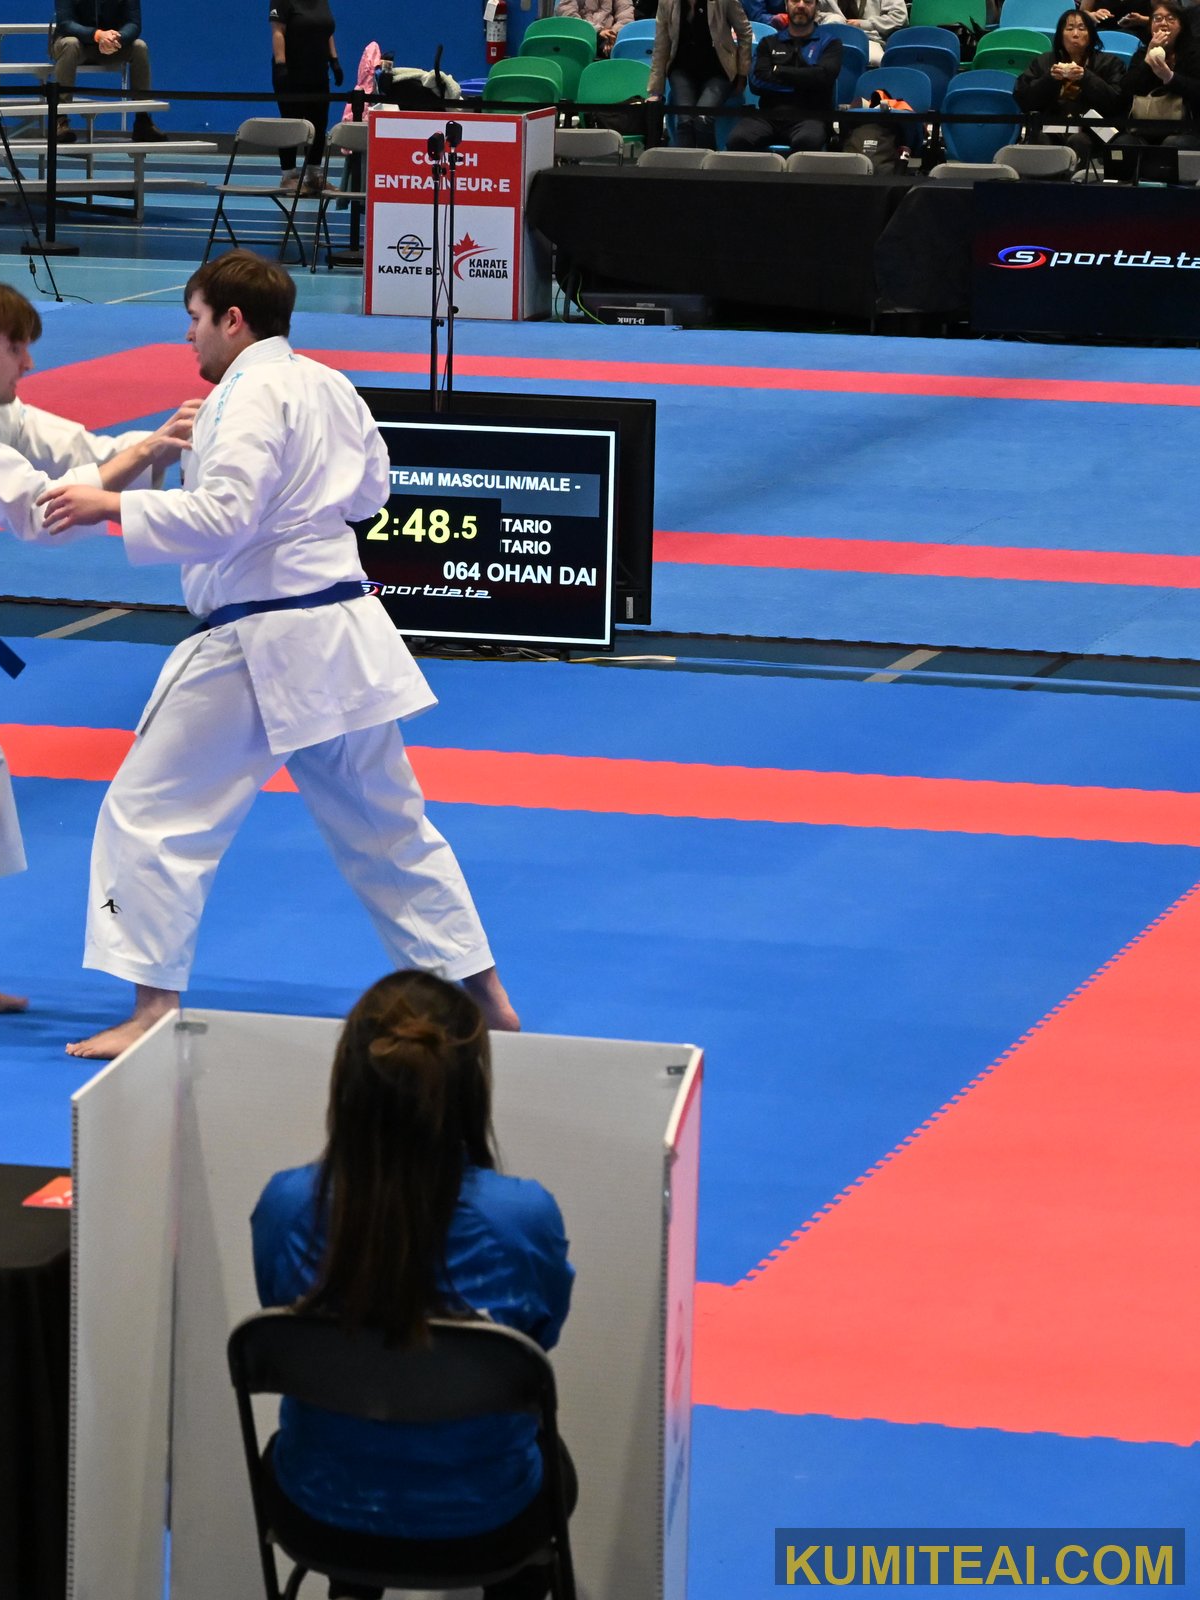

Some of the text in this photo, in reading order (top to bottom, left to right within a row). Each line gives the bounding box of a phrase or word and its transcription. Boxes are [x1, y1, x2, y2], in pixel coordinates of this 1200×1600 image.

[469, 258, 508, 269] KARATE
[378, 265, 422, 275] KARATE
[469, 268, 508, 279] CANADA
[390, 470, 433, 486] TEAM
[438, 472, 571, 492] MASCULIN/MALE
[443, 561, 597, 586] 064 OHAN DAI
